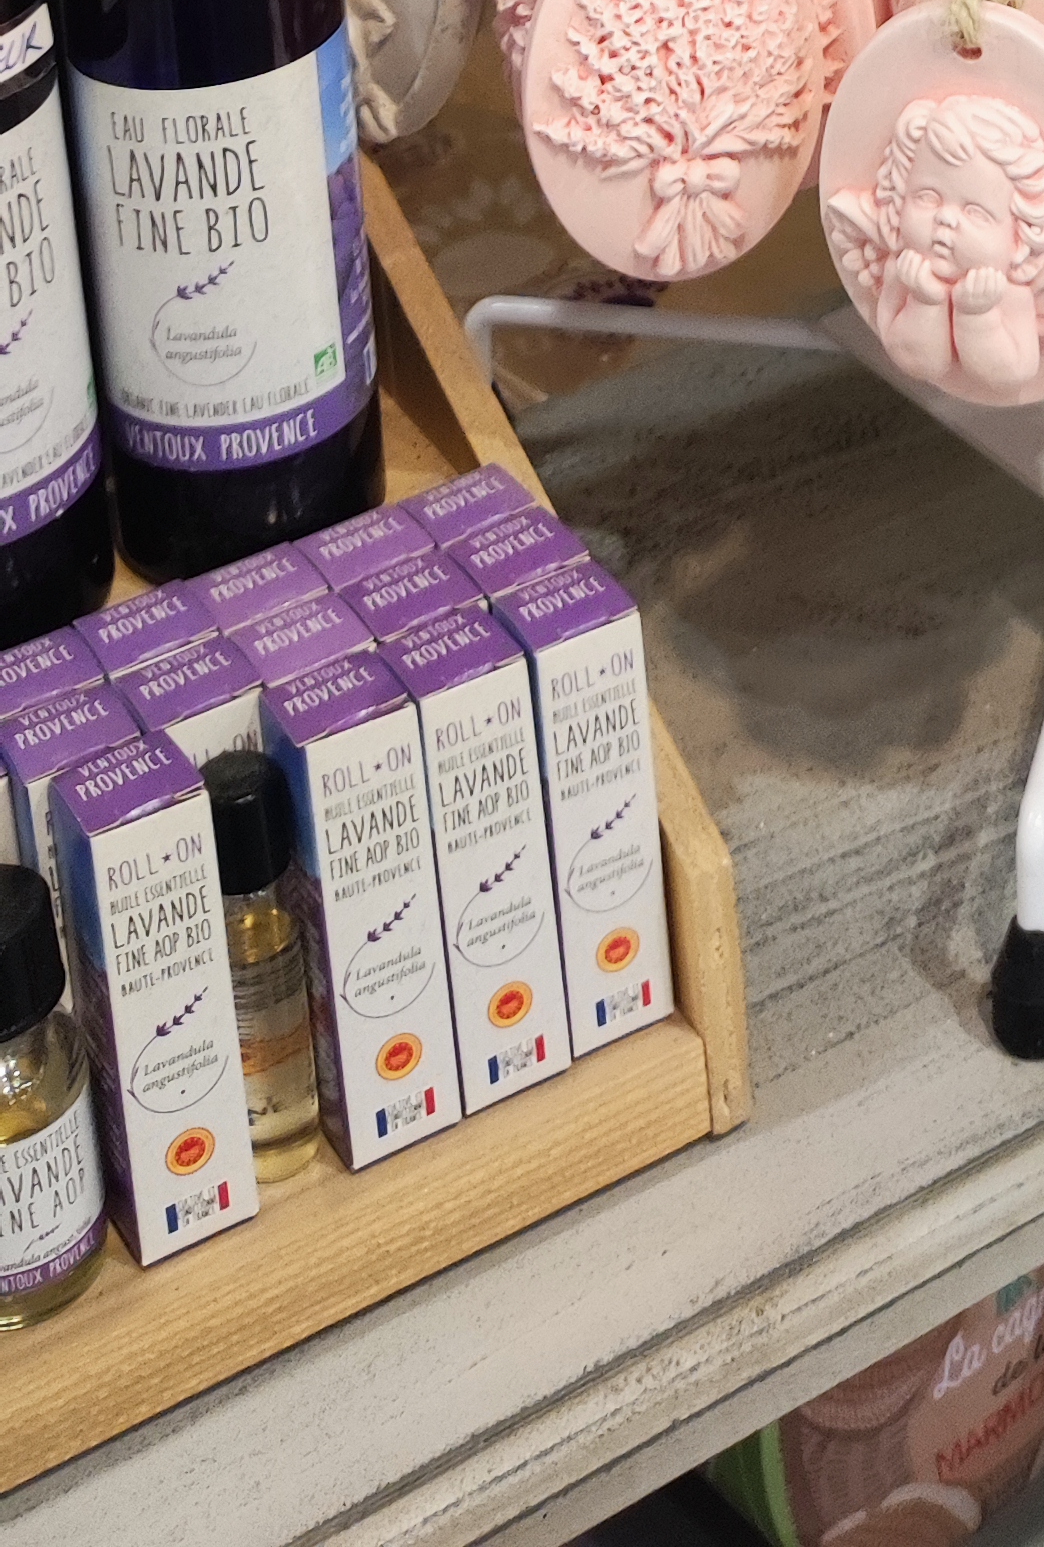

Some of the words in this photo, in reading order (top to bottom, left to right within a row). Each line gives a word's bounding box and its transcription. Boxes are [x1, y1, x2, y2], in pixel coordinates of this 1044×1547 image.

[111, 111, 145, 143] EAU
[161, 106, 252, 145] FLORALE
[0, 147, 37, 194] RALE
[107, 140, 266, 202] LAVANDE
[0, 178, 49, 255] NDE
[116, 202, 192, 255] FINE
[205, 196, 270, 253] BIO
[6, 236, 55, 307] BIO
[165, 345, 244, 365] angustifolia
[166, 326, 238, 342] Lavandula
[126, 421, 207, 461] VENTOUX
[219, 409, 319, 461] PROVENCE
[28, 443, 96, 523] PROVENCE
[423, 477, 505, 519] PROVENCE
[319, 517, 405, 559] PROVENCE
[470, 522, 555, 568] PROVENCE
[209, 557, 297, 603] PROVENCE
[363, 565, 449, 610] PROVENCE
[519, 576, 606, 621] PROVENCE
[98, 596, 188, 644] PROVENCE
[254, 608, 343, 655] PROVENCE
[402, 613, 467, 648] VENTOUX
[0, 644, 74, 686] OVENCE
[401, 621, 491, 669] PROVENCE
[139, 651, 231, 700] PROVENCE
[283, 666, 375, 717] PROVENCE
[286, 657, 353, 695] VENTOUX
[550, 666, 595, 702] ROLL
[611, 647, 634, 677] ON
[14, 699, 109, 750] PROVENCE
[18, 693, 89, 726] VENTOUX
[435, 715, 482, 753] ROLL
[497, 696, 522, 726] ON
[553, 698, 641, 757] LAVANDE
[75, 747, 172, 801] PROVENCE
[78, 739, 149, 777] VENTOUX
[322, 761, 370, 798] ROLL
[387, 743, 412, 772] ON
[438, 747, 529, 808] LAVANDE
[557, 751, 586, 782] FINE
[590, 741, 613, 771] AOP
[618, 729, 641, 757] BIO
[325, 794, 420, 855] LAVANDE
[443, 804, 473, 834] FINE
[477, 792, 501, 821] AOP
[506, 780, 530, 808] BIO
[107, 853, 158, 891] ROLL
[176, 833, 202, 862] ON
[330, 851, 361, 881] FINE
[366, 840, 390, 869] AOP
[396, 827, 420, 856] BIO
[577, 858, 645, 894] angustifolia
[579, 844, 641, 879] Lavandula
[111, 885, 210, 949] LAVANDE
[466, 909, 536, 948] angustifolia
[467, 895, 532, 931] Lavandula
[116, 944, 149, 976] FINE
[154, 932, 179, 962] AOP
[186, 918, 211, 948] BIO
[356, 945, 422, 981] Lavandula
[354, 960, 426, 998] angustifolia
[143, 1053, 219, 1092] angustifolia
[144, 1038, 214, 1076] Lavandula
[14, 1109, 80, 1170] ESSENTIELLE
[0, 1133, 83, 1206] VANDE
[53, 1167, 86, 1219] AOP
[0, 1268, 43, 1294] NTOUX
[49, 1233, 96, 1277] PROVENCE
[932, 1328, 988, 1400] La
